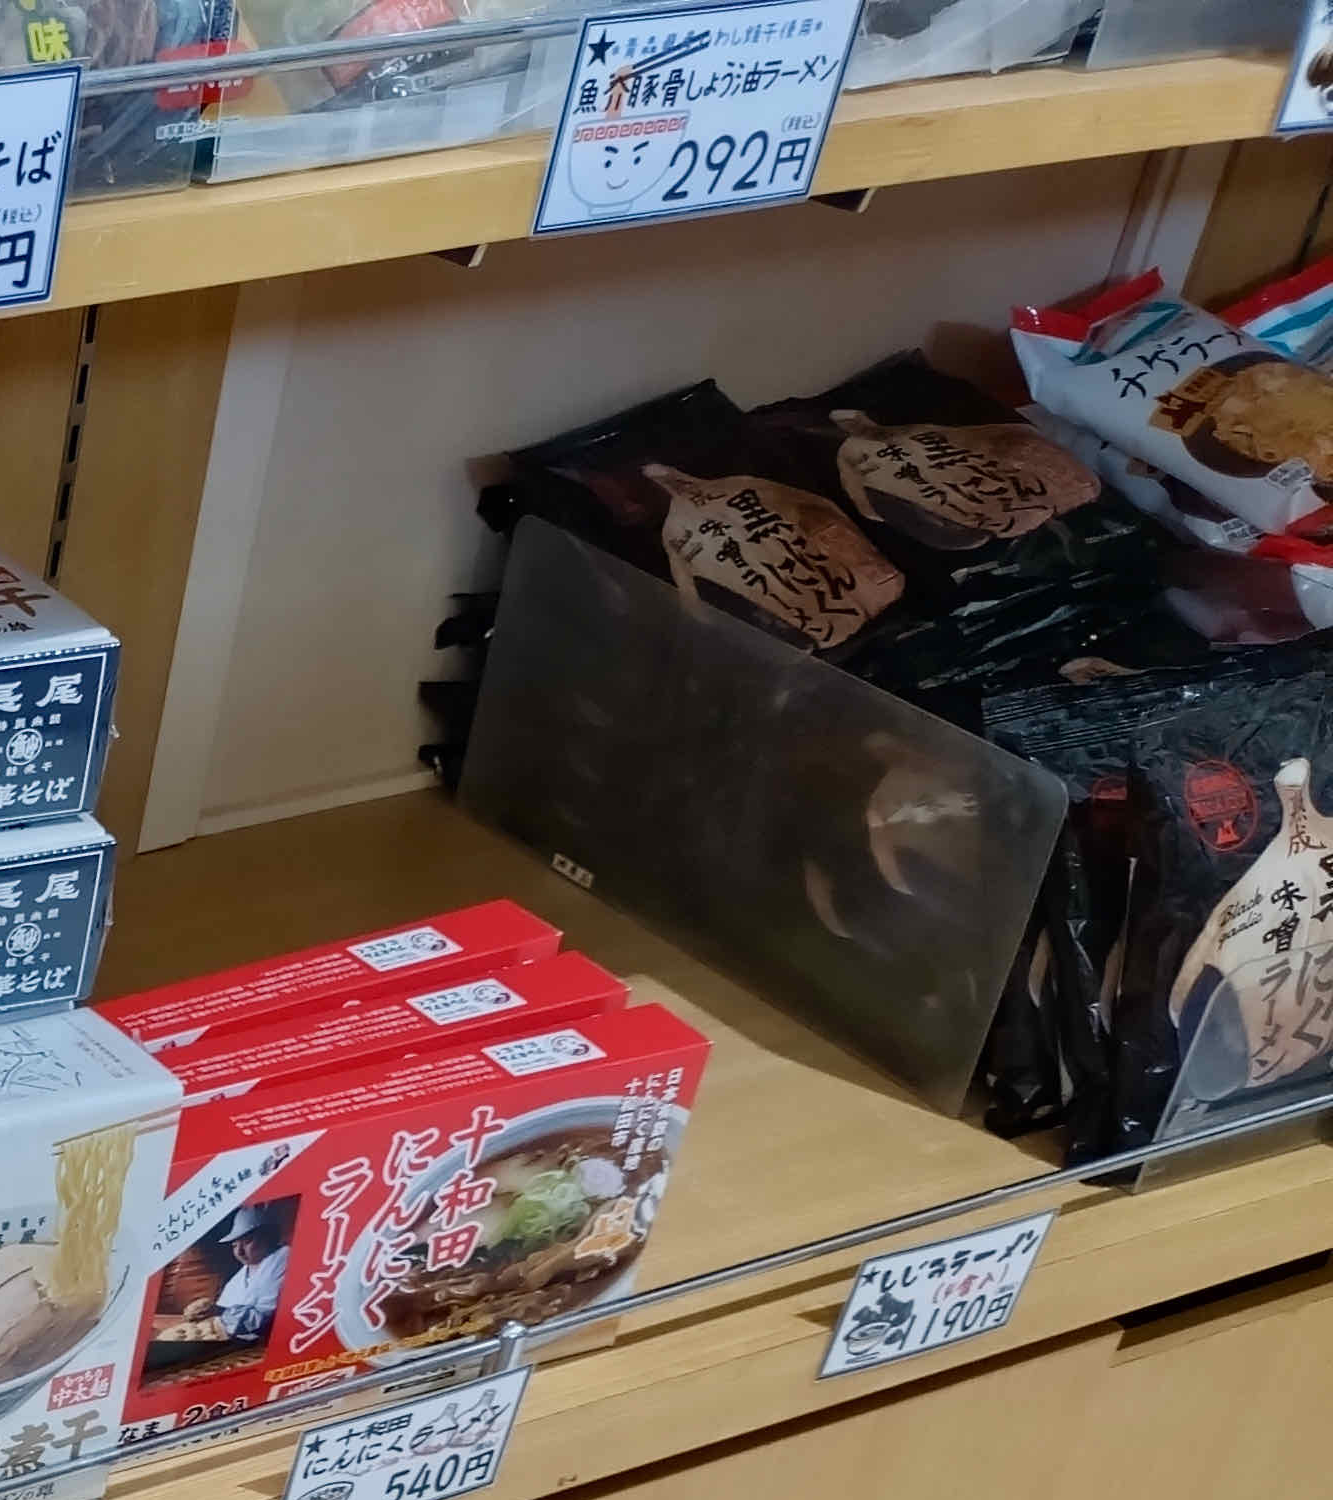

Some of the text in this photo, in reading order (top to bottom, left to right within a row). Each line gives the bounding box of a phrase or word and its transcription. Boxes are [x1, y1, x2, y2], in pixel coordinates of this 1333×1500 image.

[573, 54, 840, 115] 魚介豚骨しょう油ラーメン
[661, 129, 812, 202] 292円
[1250, 879, 1308, 1081] 味噌ラーメン
[426, 1105, 506, 1273] 十和田
[288, 1155, 374, 1355] ラーメン
[360, 1126, 441, 1332] にんにく
[117, 1420, 161, 1445] なま
[303, 1401, 511, 1480] にんにくラーメン
[335, 1412, 414, 1445] 十和田
